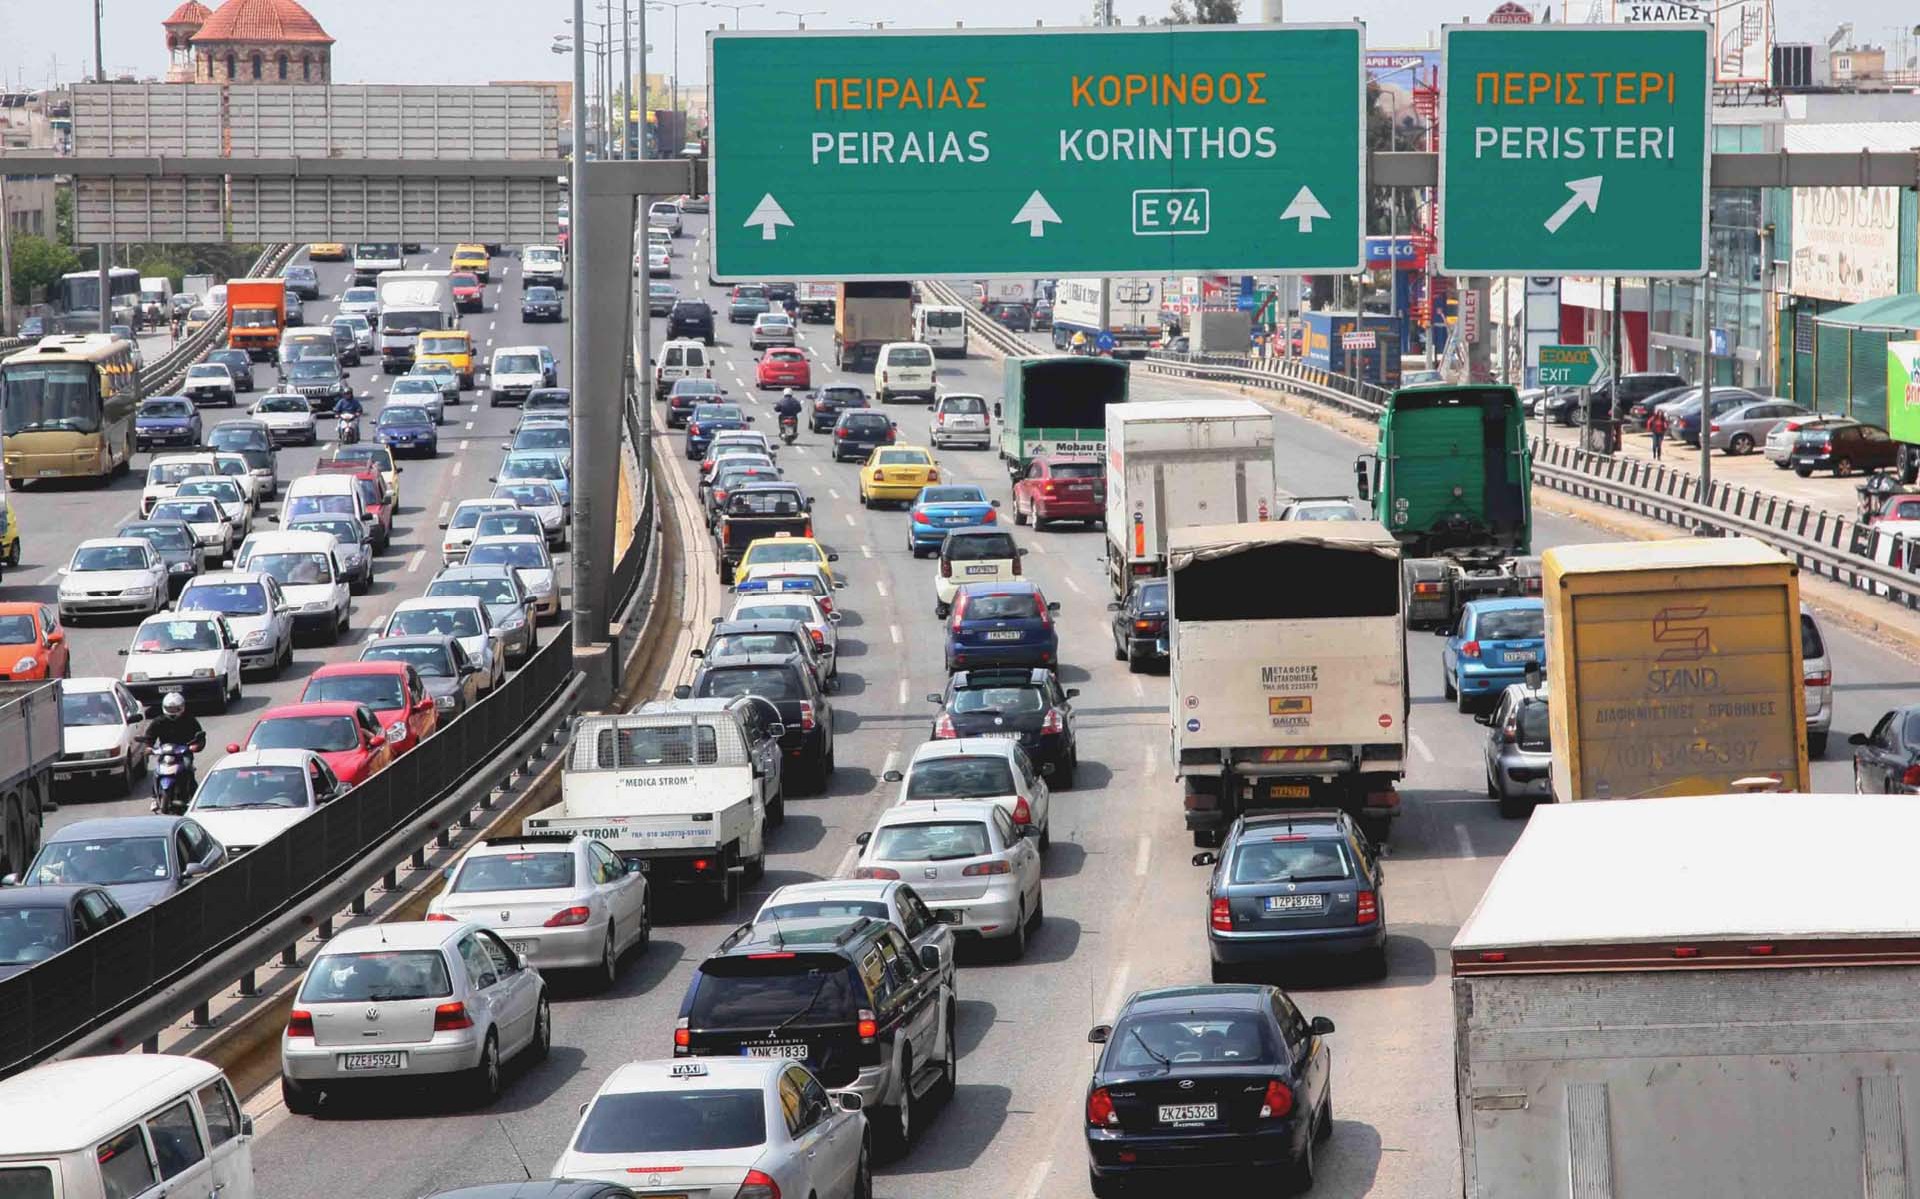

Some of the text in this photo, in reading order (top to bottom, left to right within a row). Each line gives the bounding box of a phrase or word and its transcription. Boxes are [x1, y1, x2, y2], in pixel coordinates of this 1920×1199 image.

[1631, 5, 1700, 21] ΣΚΑΛΕΣ
[814, 73, 1267, 111] ΠΕΙΡΑΙΑΣ ΚΟΡΙΝΘΟΣ
[1475, 72, 1676, 105] ΠΕΡΙΣΤΕΡΙ
[811, 126, 1278, 164] PEIRAIAS KORINTHOS
[1474, 127, 1675, 159] PERISTERI
[1142, 199, 1200, 226] E 94
[1373, 245, 1414, 256] EKO
[1465, 291, 1475, 341] OUTLET
[1539, 368, 1570, 381] EXIT
[1056, 443, 1094, 451] Mobau
[1649, 668, 1719, 693] STAND
[673, 1063, 700, 1074] TAXI
